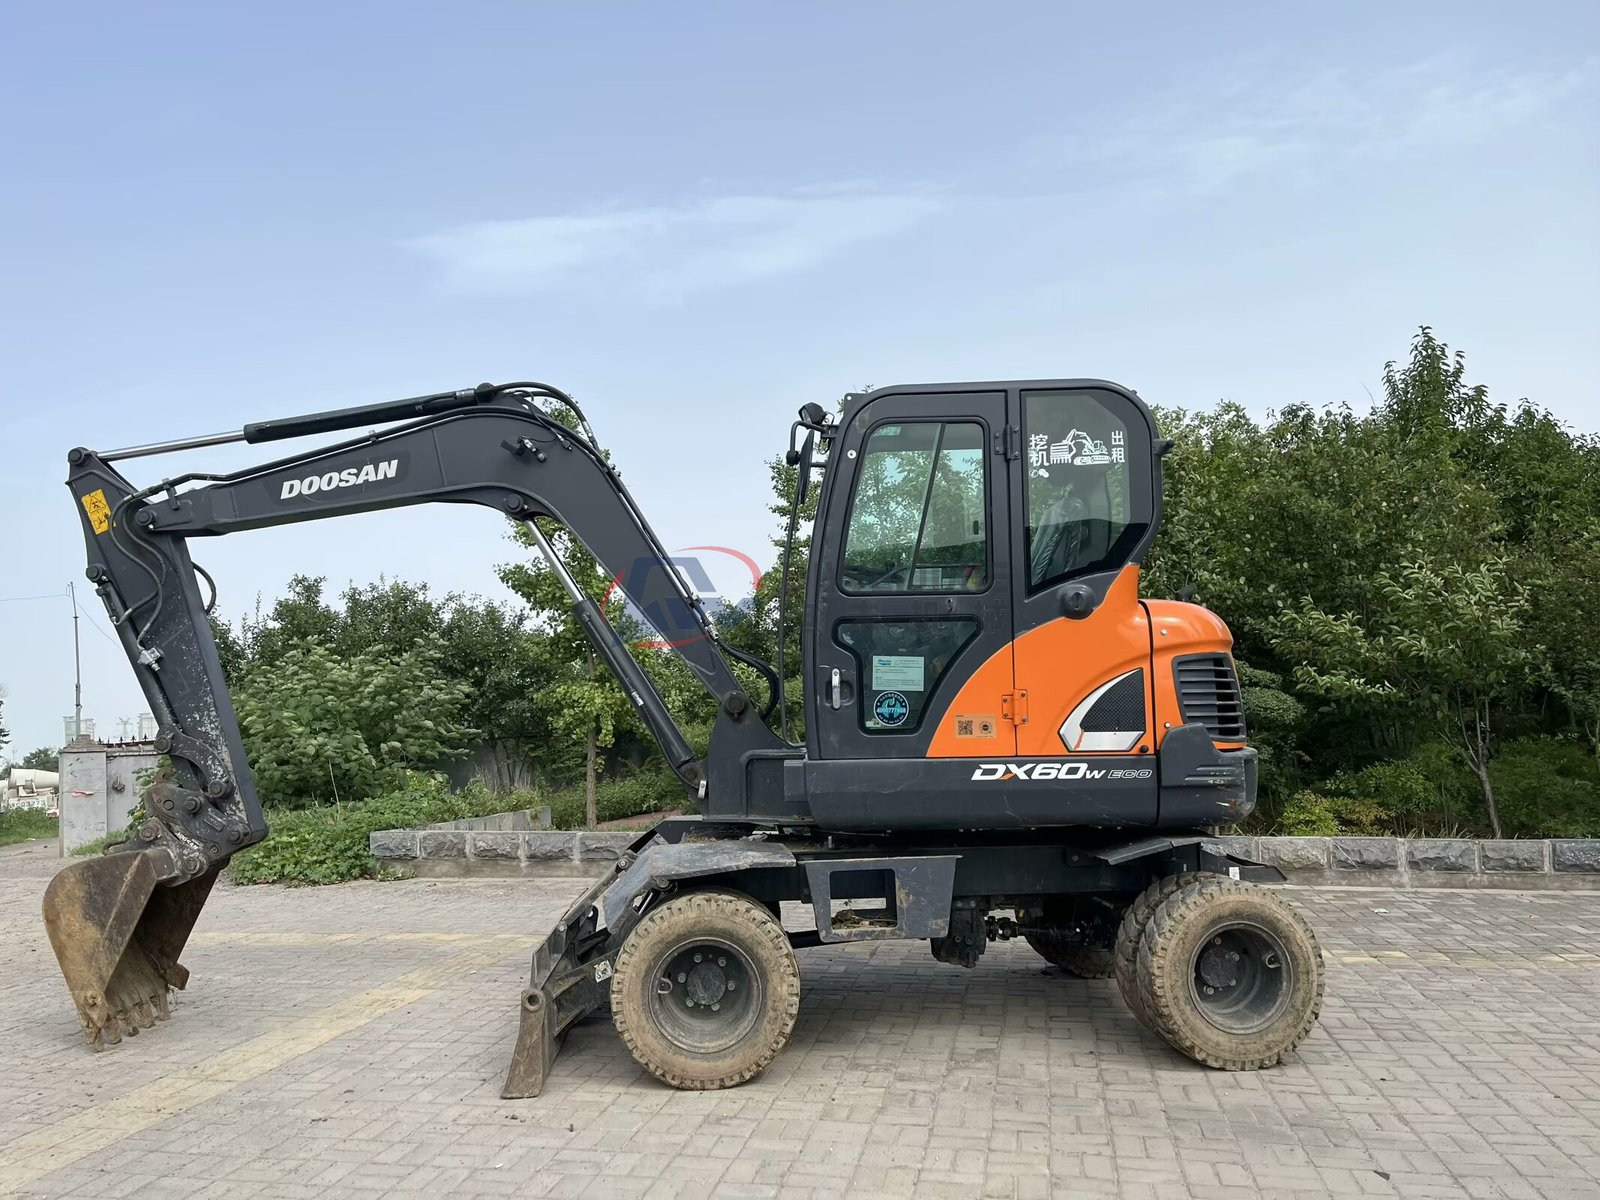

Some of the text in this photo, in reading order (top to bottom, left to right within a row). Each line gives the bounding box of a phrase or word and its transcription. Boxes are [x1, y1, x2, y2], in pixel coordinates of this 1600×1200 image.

[1029, 433, 1050, 467] 挖机
[1111, 430, 1125, 463] 出租
[280, 459, 399, 500] DOOSAN
[1107, 769, 1152, 779] ECO
